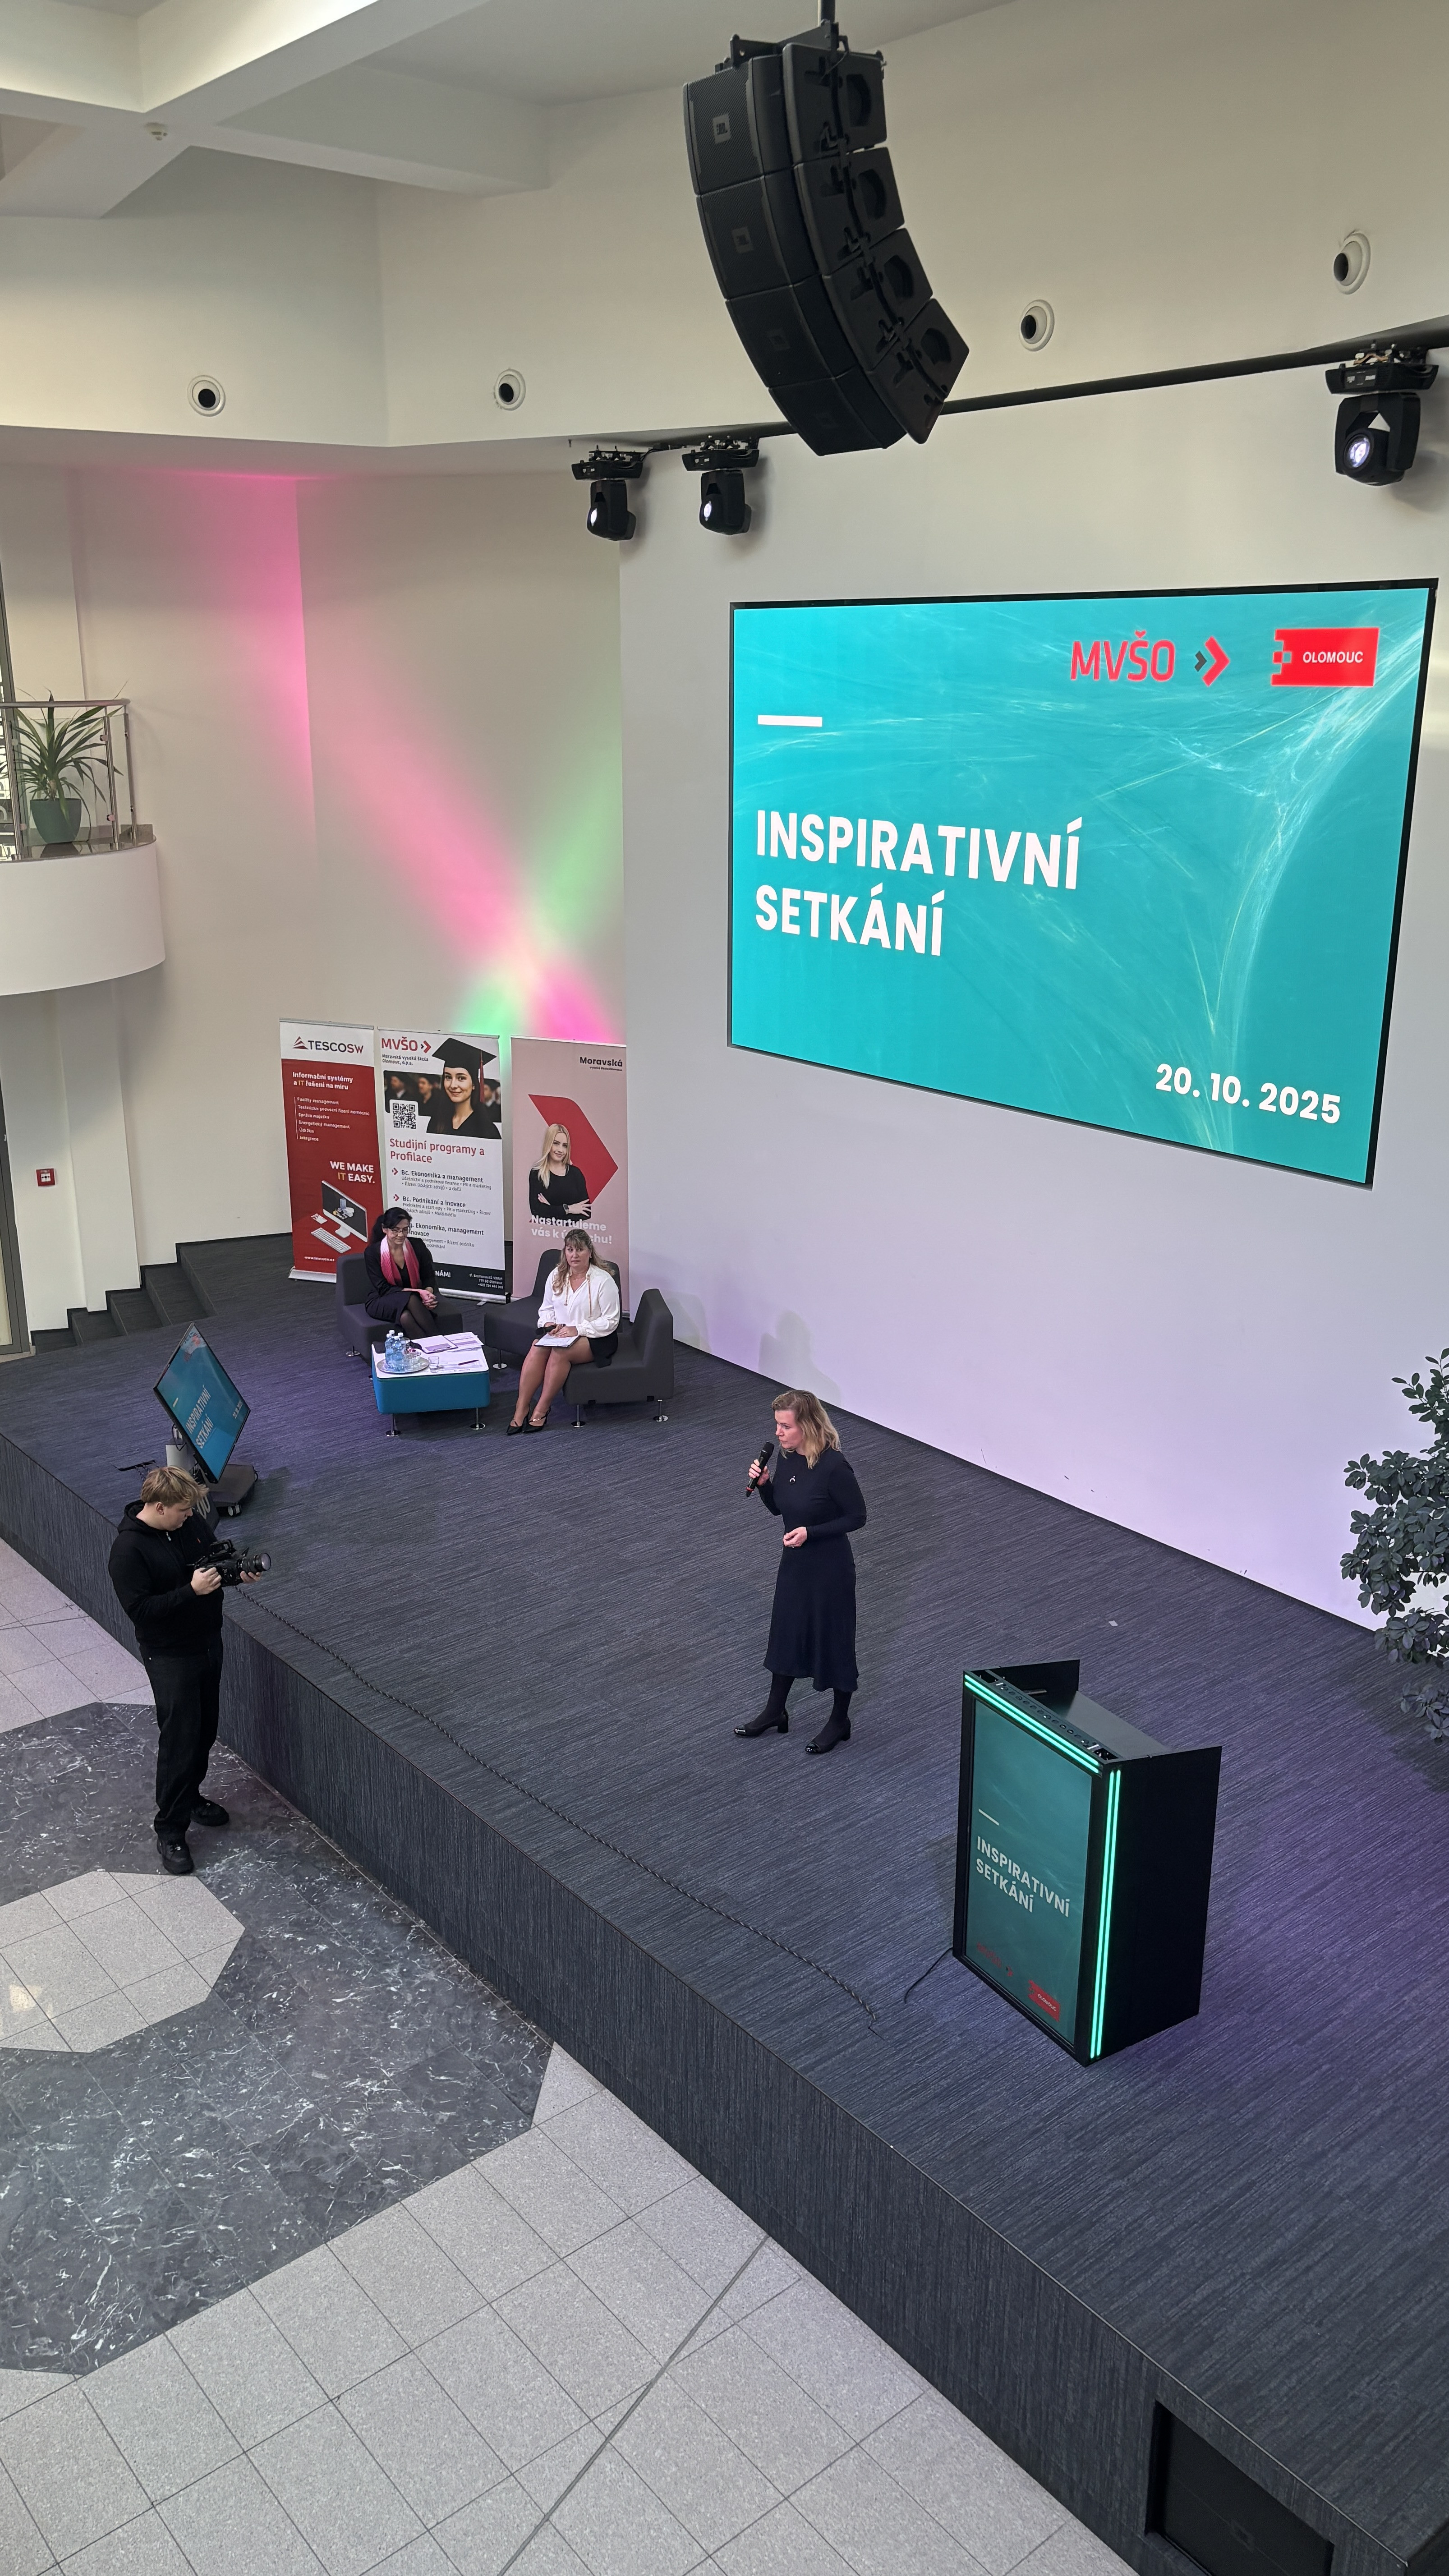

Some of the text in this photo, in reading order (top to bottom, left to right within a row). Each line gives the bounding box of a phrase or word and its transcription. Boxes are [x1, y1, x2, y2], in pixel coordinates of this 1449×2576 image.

[1071, 630, 1175, 681] MVŠO
[1303, 651, 1363, 663] OLOMOUC
[757, 810, 1082, 890] INSPIRATIVNÍ
[755, 883, 945, 956] SETKÁNÍ
[382, 1036, 418, 1051] MVŠO
[580, 1057, 622, 1067] Moravská
[293, 1072, 353, 1084] Informační systémy
[1155, 1063, 1341, 1124] 20. 10. 2025
[390, 1138, 427, 1151] Studijní
[430, 1143, 476, 1156] programy
[391, 1151, 432, 1163] Profilace
[330, 1161, 374, 1173] WE MAKE
[338, 1172, 375, 1183] IT EASY.
[413, 1197, 439, 1205] Podnikání
[415, 1223, 446, 1232] Ekonomika,
[448, 1227, 484, 1235] management
[531, 1214, 606, 1231] Nastartujeme
[531, 1227, 550, 1237] vás
[552, 1229, 558, 1238] k
[185, 1384, 211, 1434] INSPIRATIVNÍ
[196, 1413, 214, 1449] SETKÁNÍ
[976, 1836, 1070, 1918] INSPIRATIVNÍ
[975, 1858, 1034, 1913] SETKÁNÍ
